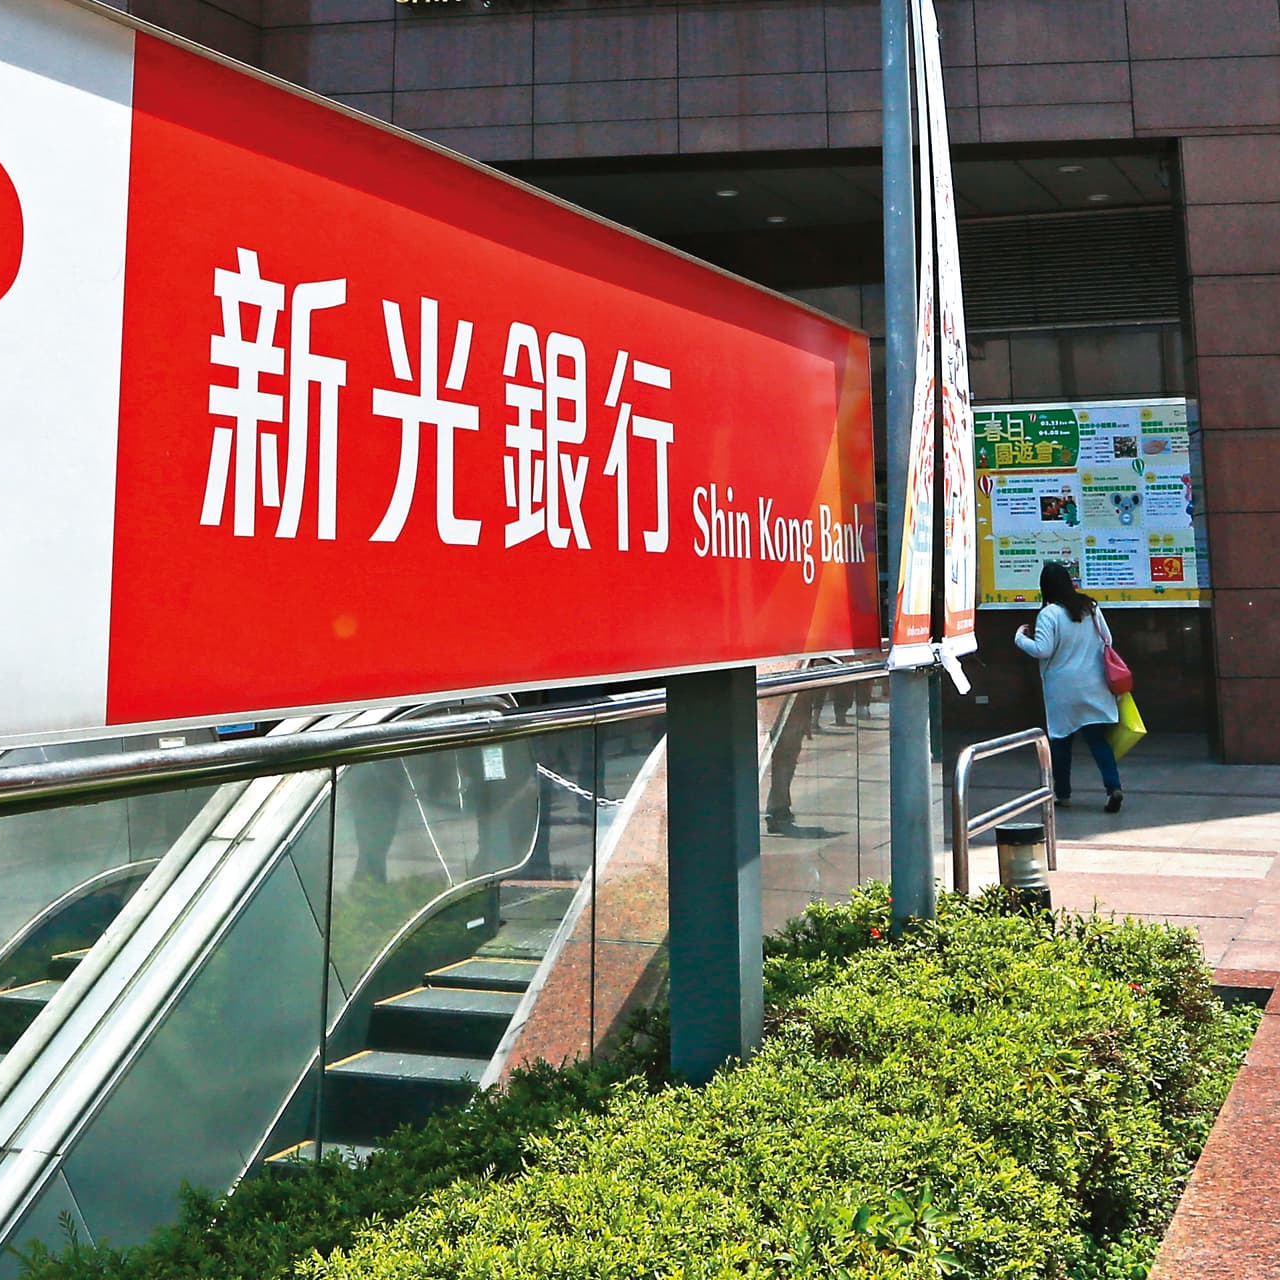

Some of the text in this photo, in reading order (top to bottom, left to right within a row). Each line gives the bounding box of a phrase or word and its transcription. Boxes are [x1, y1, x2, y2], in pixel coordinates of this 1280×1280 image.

[199, 247, 675, 554] 新光銀行
[692, 483, 866, 586] Shin Kong Bank
